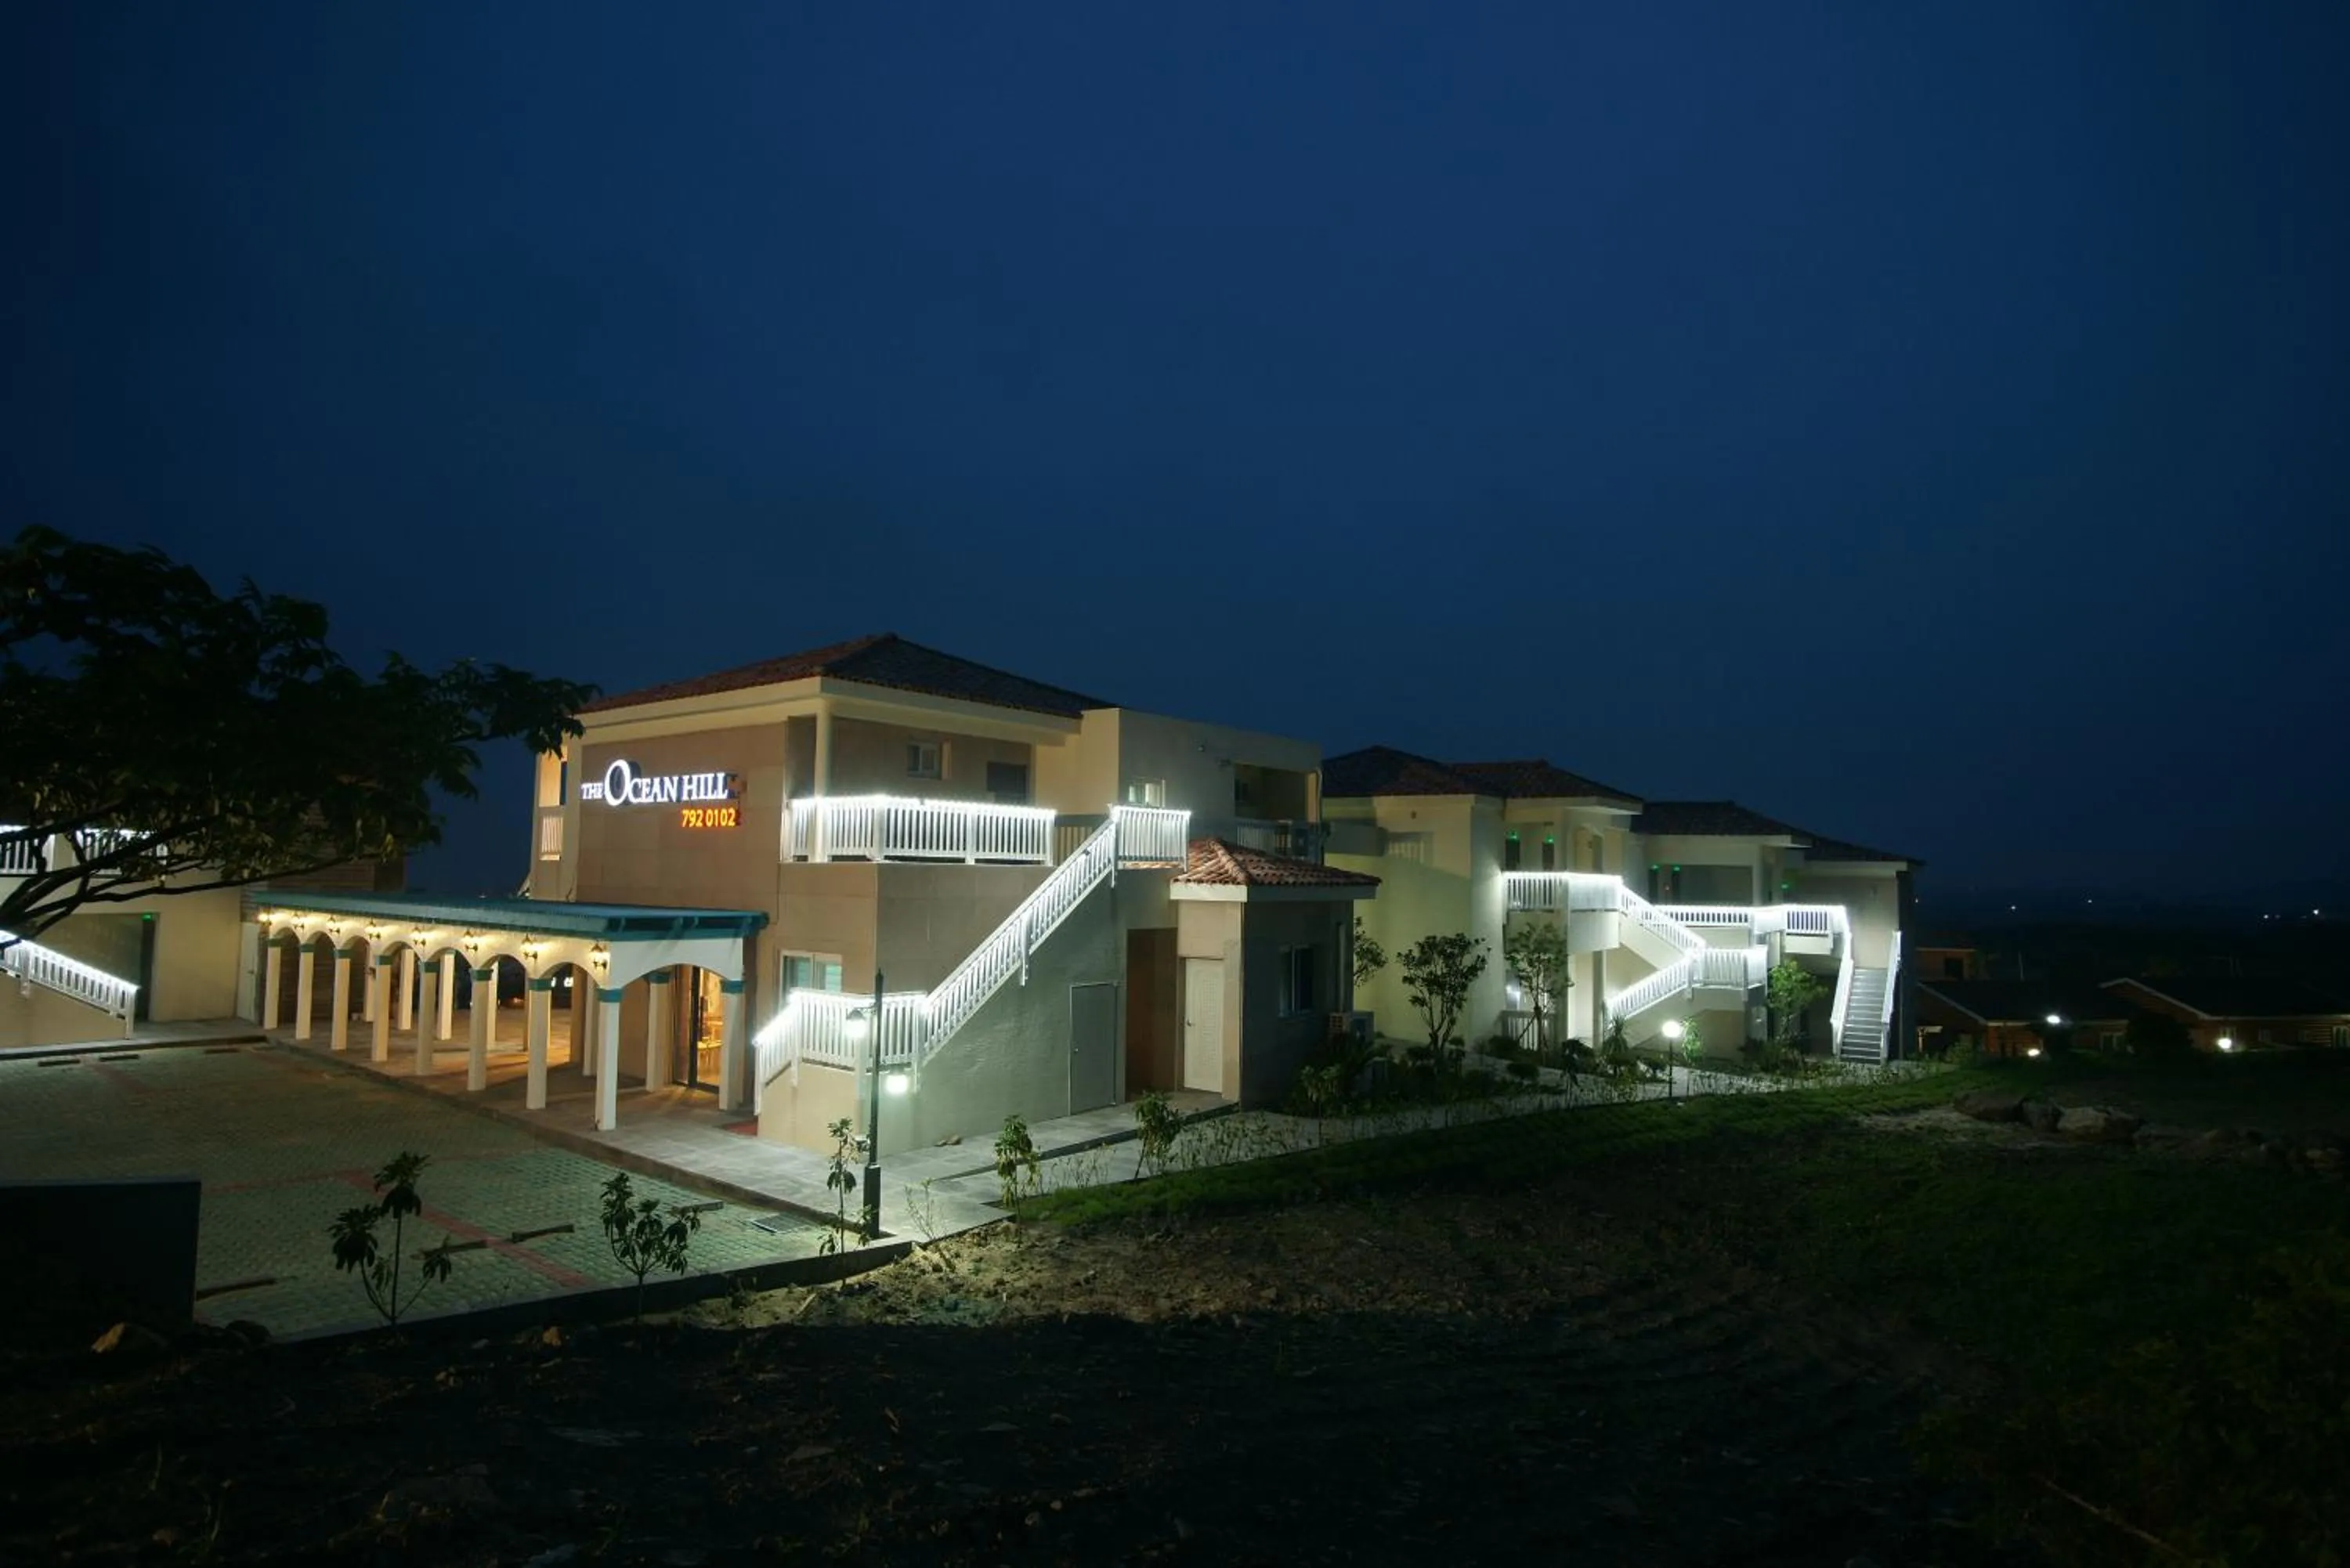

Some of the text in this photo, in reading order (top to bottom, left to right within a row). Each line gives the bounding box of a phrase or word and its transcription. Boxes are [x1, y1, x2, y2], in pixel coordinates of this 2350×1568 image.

[581, 759, 728, 807] THE OCEAN HILL
[681, 807, 736, 828] 792 0102
